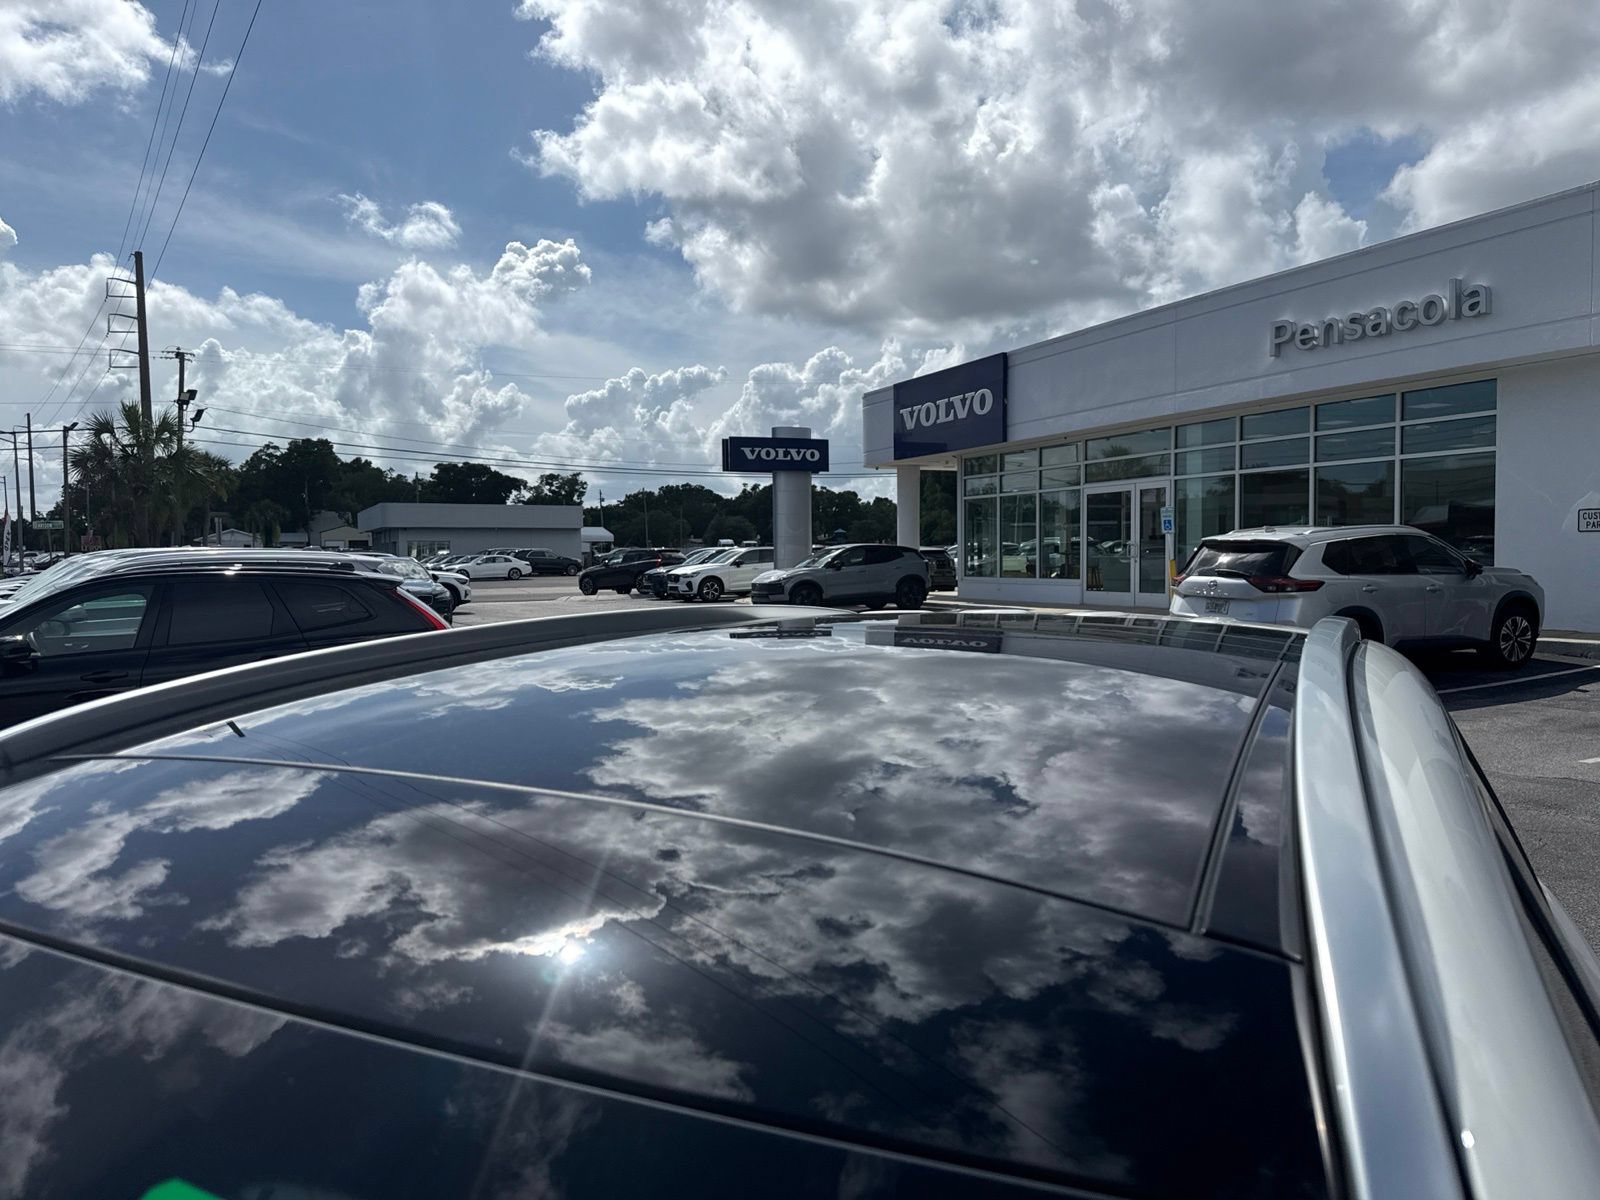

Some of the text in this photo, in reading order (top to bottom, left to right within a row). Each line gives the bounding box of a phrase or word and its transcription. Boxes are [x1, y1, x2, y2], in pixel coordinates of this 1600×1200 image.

[1270, 278, 1492, 357] Pensacola
[900, 388, 993, 431] VOLVO
[741, 447, 820, 461] VOLVO
